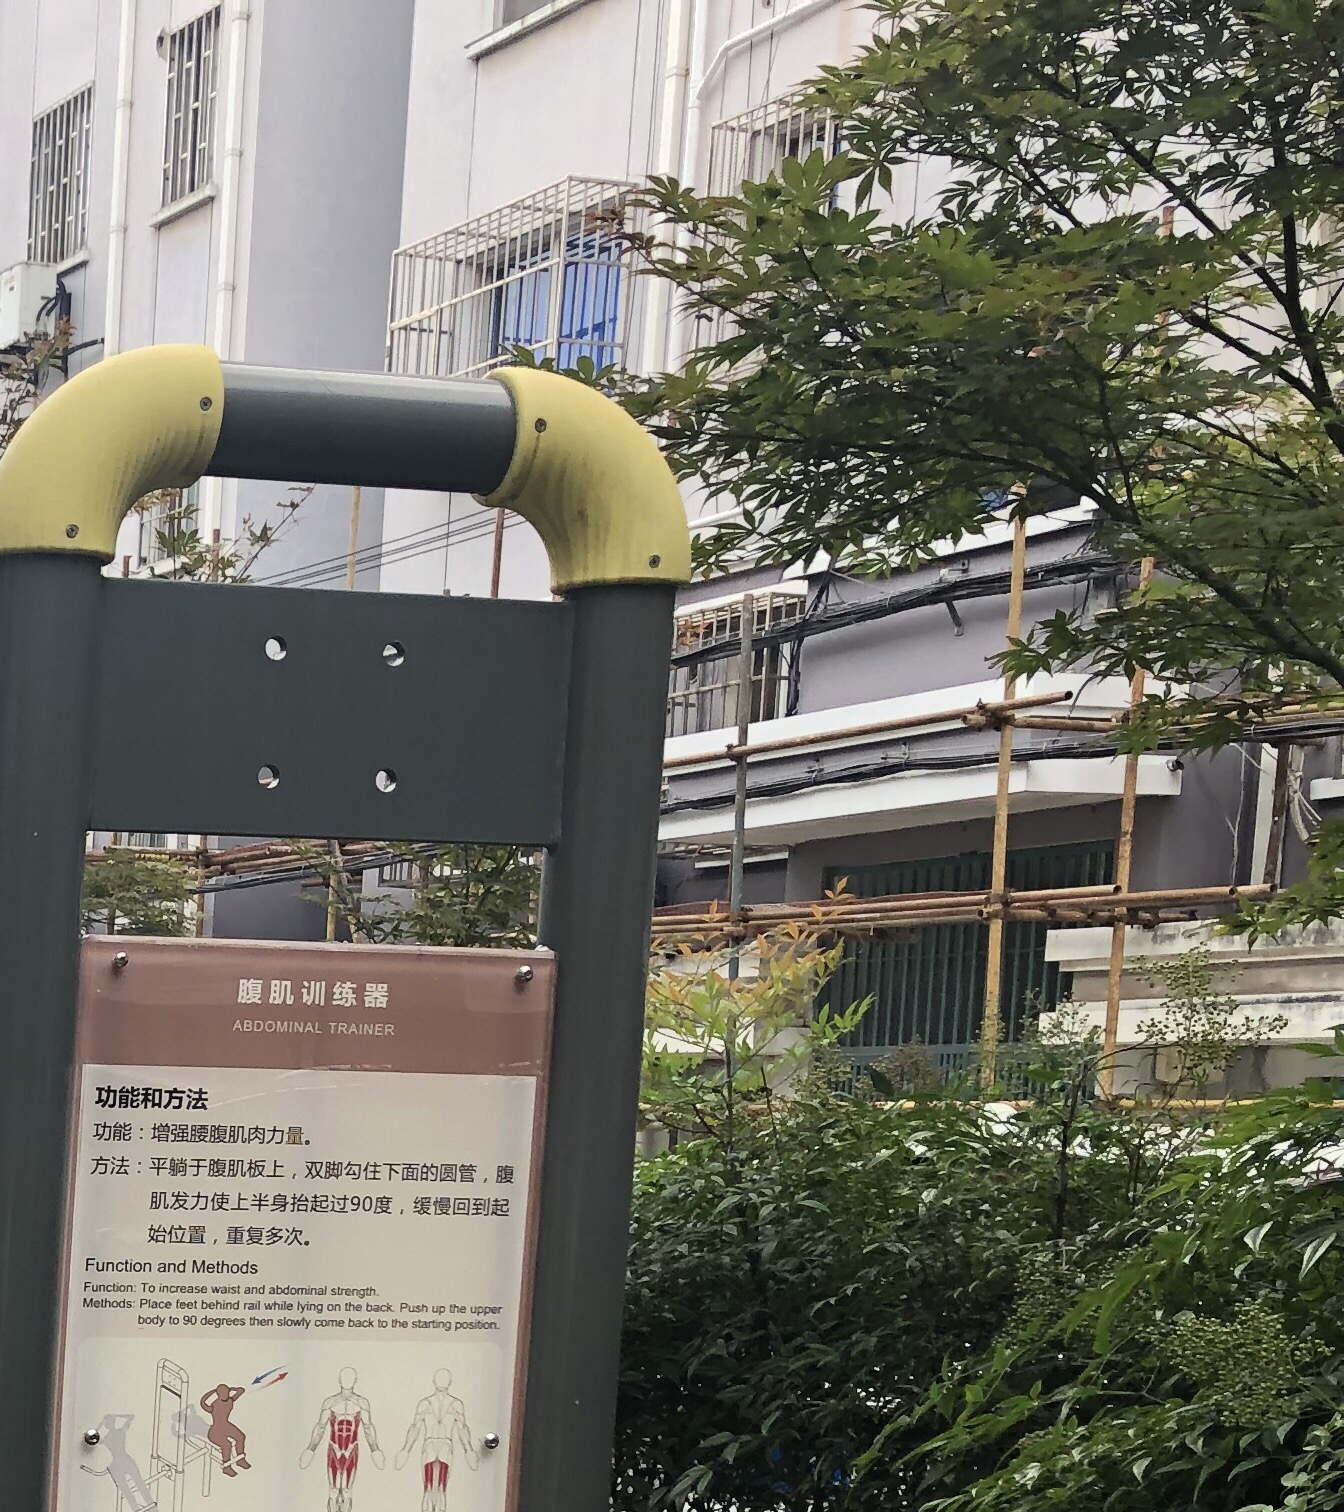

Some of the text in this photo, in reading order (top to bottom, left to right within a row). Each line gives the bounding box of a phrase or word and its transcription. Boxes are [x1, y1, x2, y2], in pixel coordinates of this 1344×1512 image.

[236, 977, 389, 1009] 腹肌训练器
[231, 1018, 395, 1036] ABDOMINAL TRAINER
[94, 1085, 209, 1111] 功能和方法
[91, 1121, 311, 1146] 功能：增强腰腹肌肉力量。
[146, 1224, 310, 1247] 始位置，重复多次。
[84, 1257, 259, 1275] Function and Methods
[157, 1282, 208, 1294] increase
[210, 1284, 241, 1295] waist
[243, 1283, 266, 1295] and
[267, 1284, 328, 1296] abdominal
[81, 1296, 503, 1317] Methods: Place feet behind rail while lying the Push the upper
[136, 1313, 167, 1328] body
[181, 1314, 198, 1326] 90
[199, 1314, 246, 1329] degrees
[248, 1315, 274, 1327] then
[276, 1316, 312, 1330] slowly
[313, 1318, 346, 1328] come
[347, 1316, 375, 1329] back
[390, 1317, 409, 1329] the
[410, 1318, 452, 1332] starting
